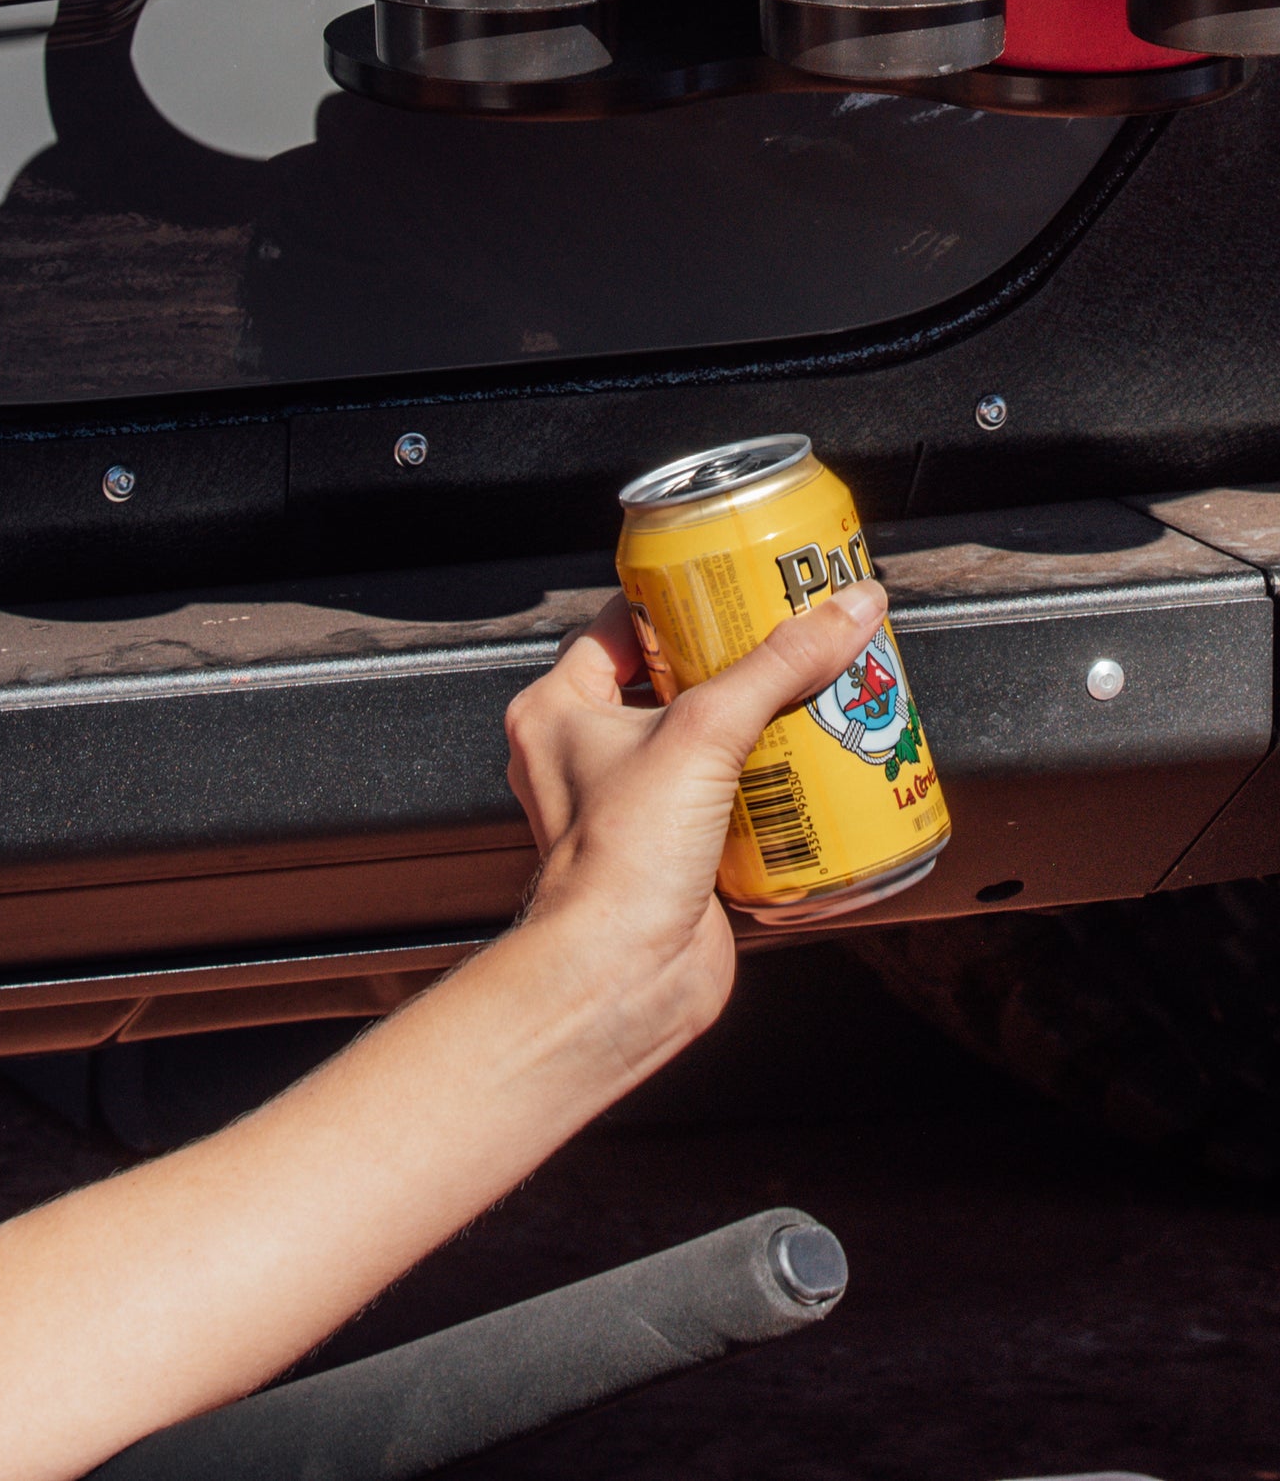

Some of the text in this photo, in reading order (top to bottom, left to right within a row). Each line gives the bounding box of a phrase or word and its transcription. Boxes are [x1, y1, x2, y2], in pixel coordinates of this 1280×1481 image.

[788, 771, 808, 811] 95030
[892, 786, 917, 811] La
[802, 815, 822, 855] 33544
